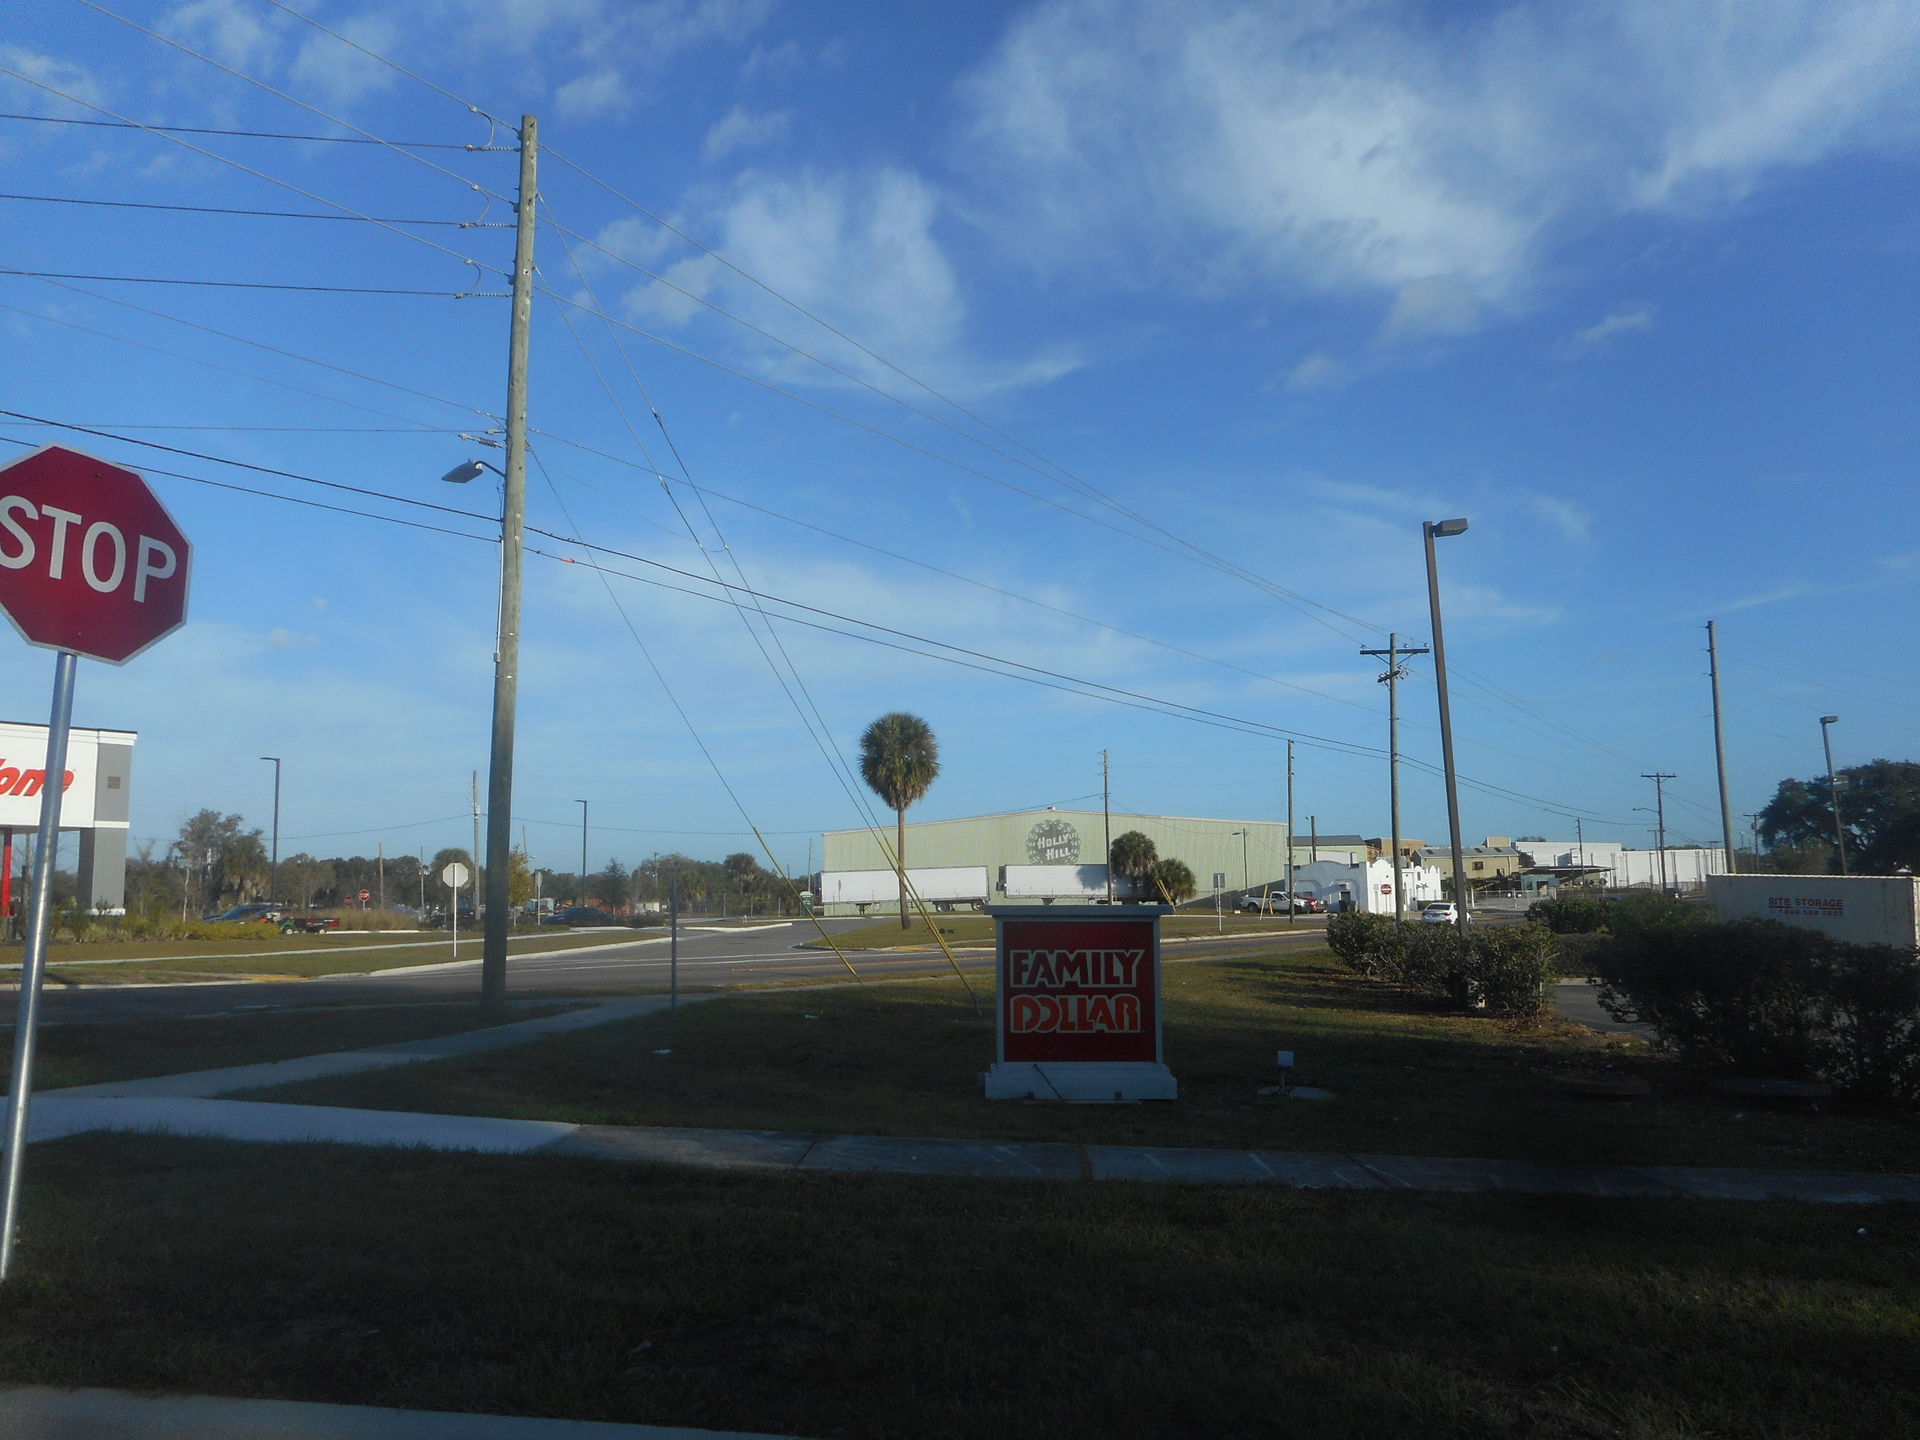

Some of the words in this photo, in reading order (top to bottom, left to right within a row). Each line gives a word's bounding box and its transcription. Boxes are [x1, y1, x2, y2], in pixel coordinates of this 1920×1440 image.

[0, 495, 177, 604] STOP
[1037, 833, 1070, 850] HOLLY
[1046, 847, 1071, 860] HILL
[1767, 897, 1791, 906] SITE
[1794, 898, 1844, 907] STORAGE
[1010, 949, 1145, 988] FAMILY
[1010, 993, 1141, 1034] DOLLAR
